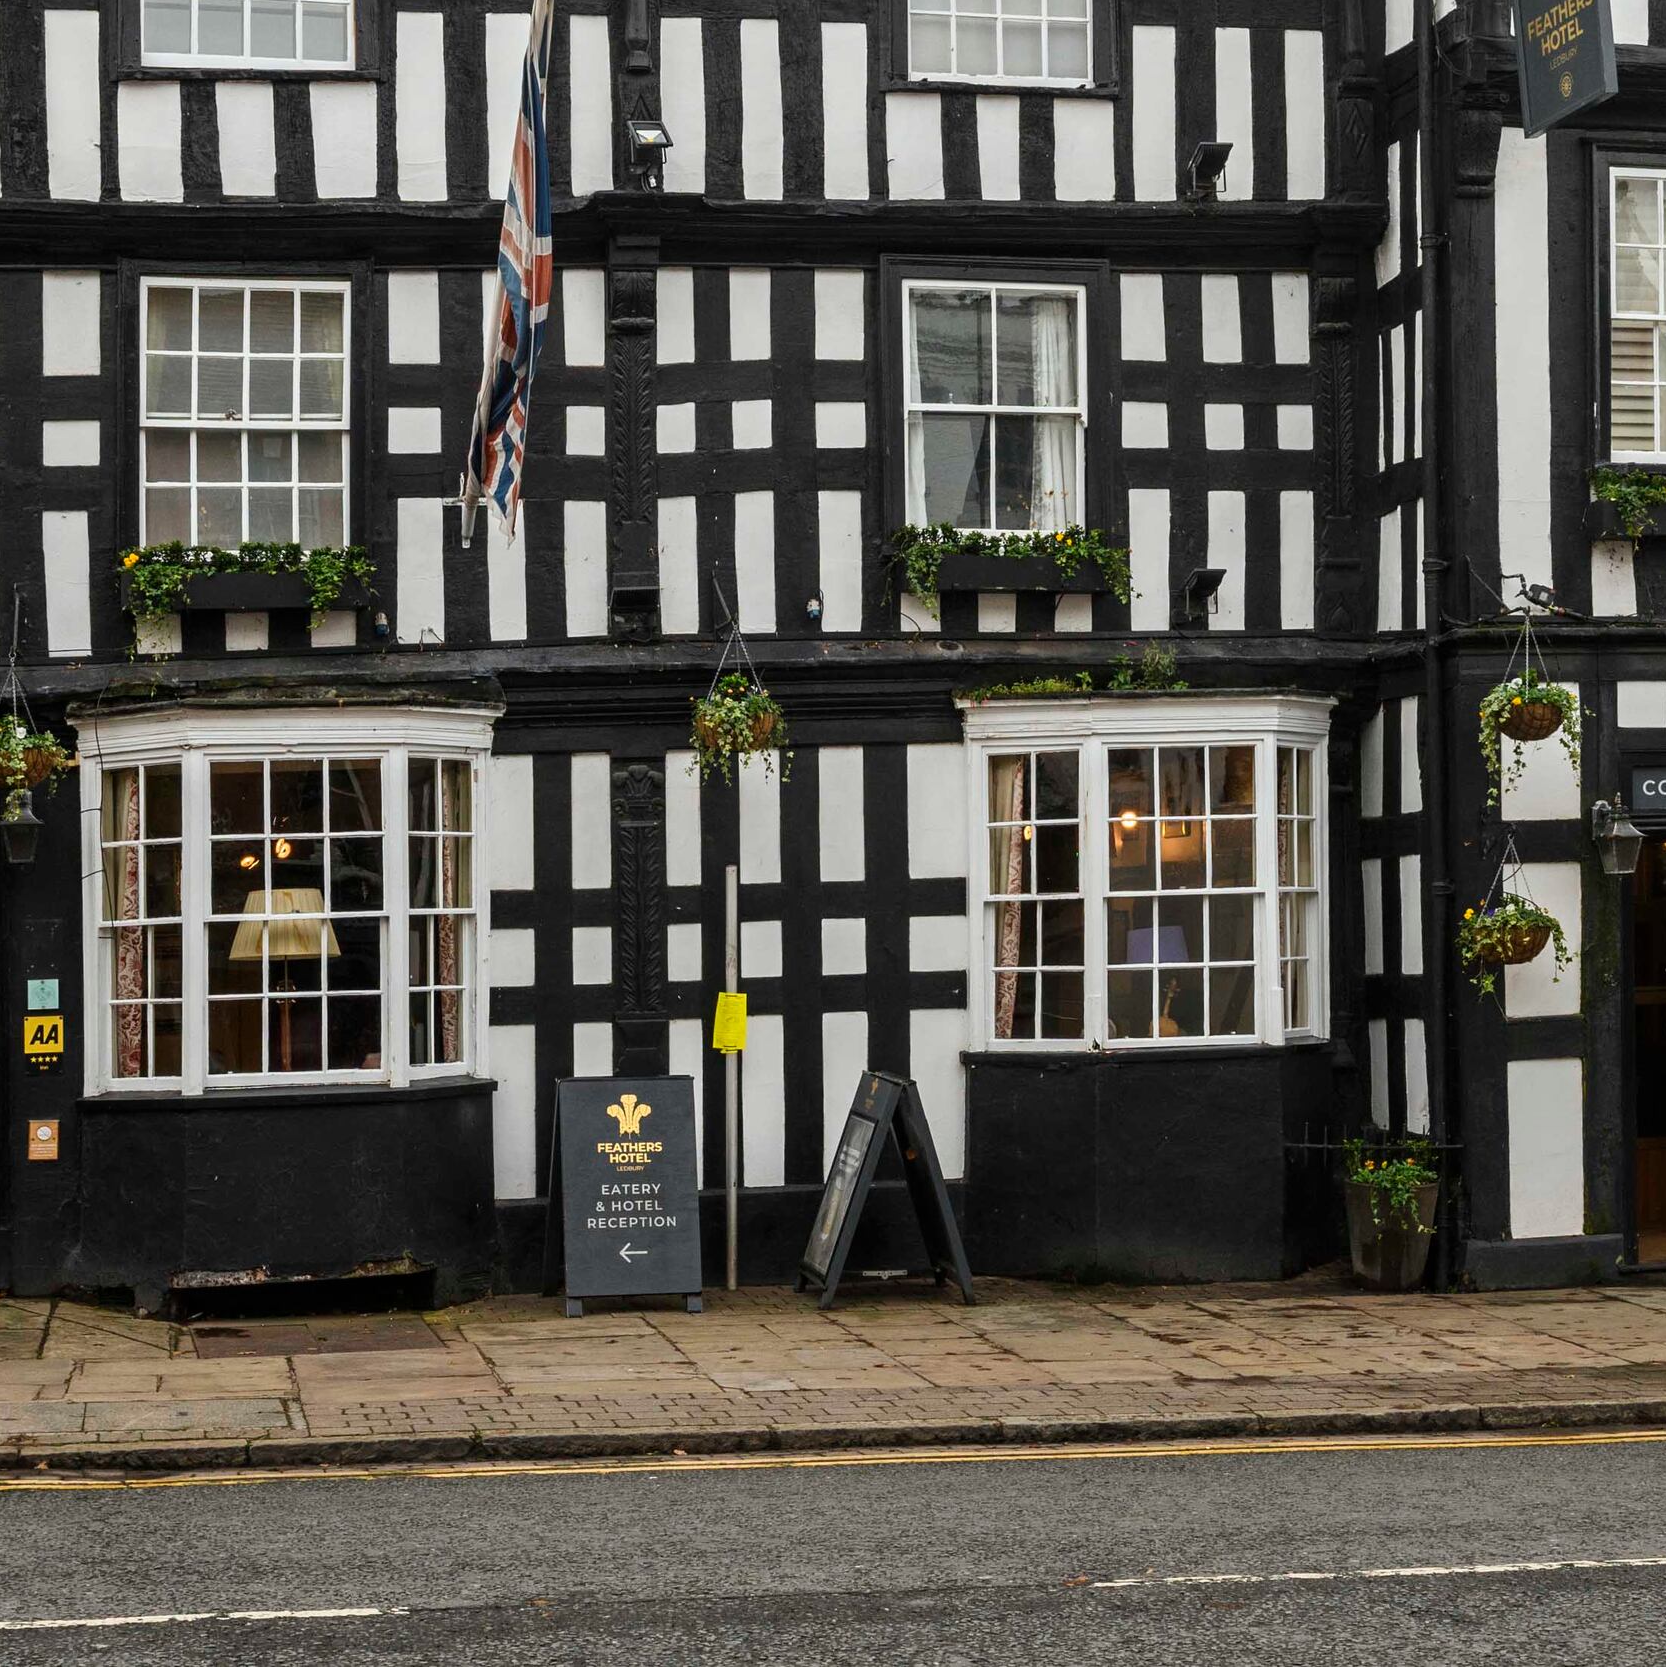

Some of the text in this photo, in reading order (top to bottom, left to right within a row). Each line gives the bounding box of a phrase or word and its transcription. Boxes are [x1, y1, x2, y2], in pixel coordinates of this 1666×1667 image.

[1541, 17, 1584, 56] HOTEL
[1549, 45, 1579, 70] LEDBURY
[30, 1024, 59, 1045] AA
[597, 1142, 663, 1153] FEATHERS
[609, 1153, 652, 1164] HOTEL
[601, 1184, 661, 1195] EATERY
[595, 1200, 663, 1212] & HOTEL
[587, 1216, 677, 1229] RECEPTION
